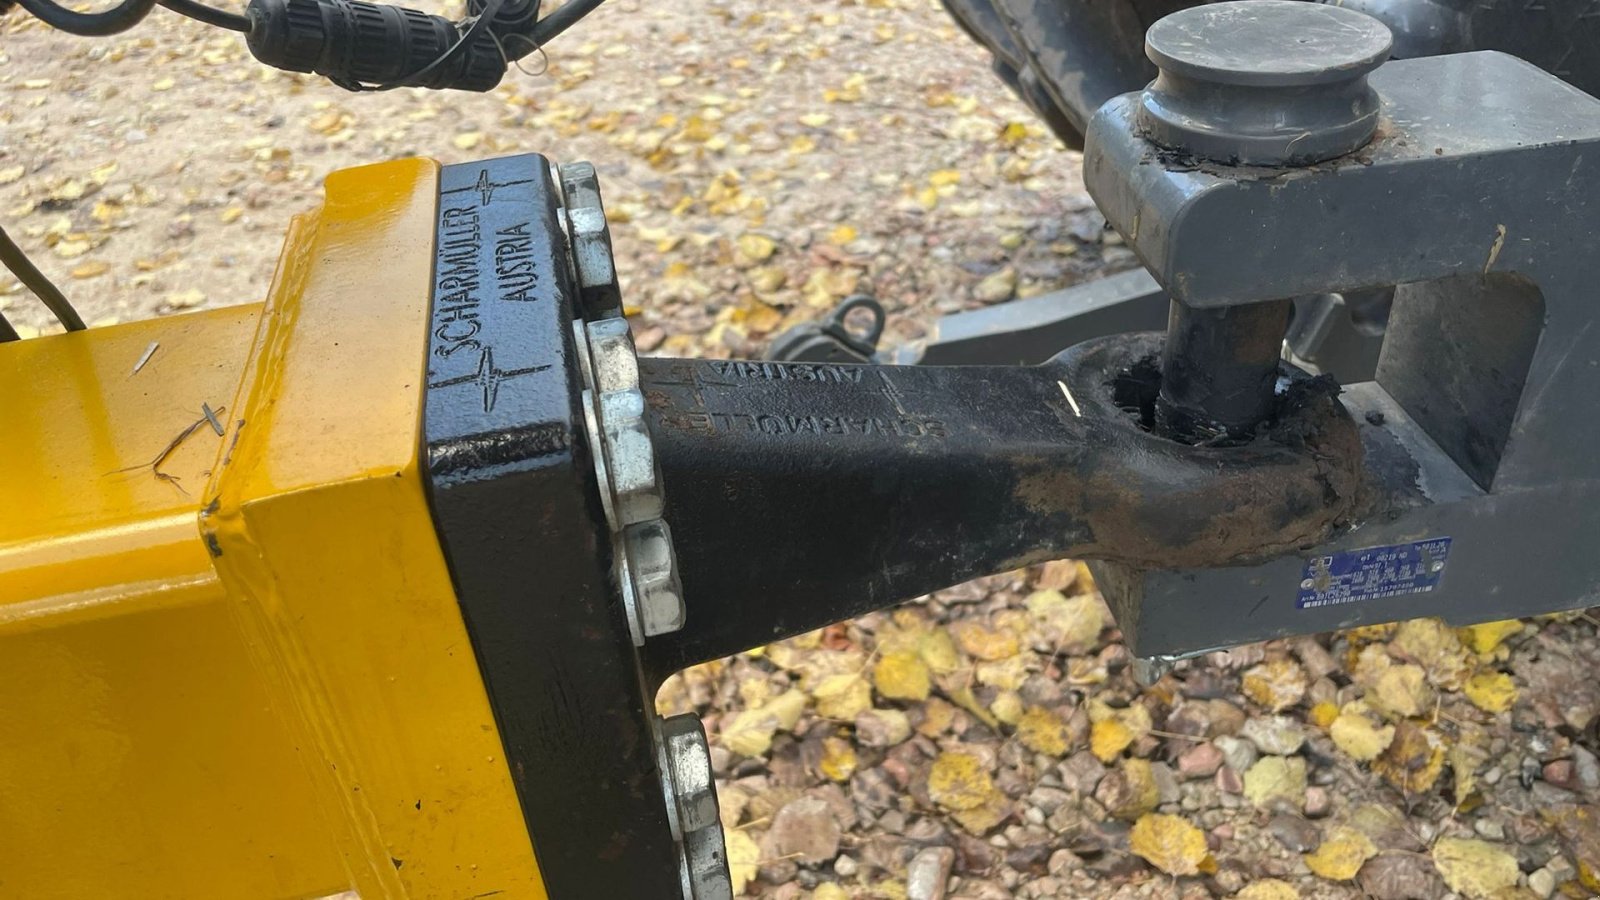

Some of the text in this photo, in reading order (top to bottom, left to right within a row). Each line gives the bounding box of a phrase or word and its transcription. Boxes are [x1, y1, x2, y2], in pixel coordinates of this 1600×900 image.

[435, 205, 481, 360] SCHARMÜLLER
[496, 222, 538, 301] AUSTRIA
[707, 361, 863, 383] AUSTRIA
